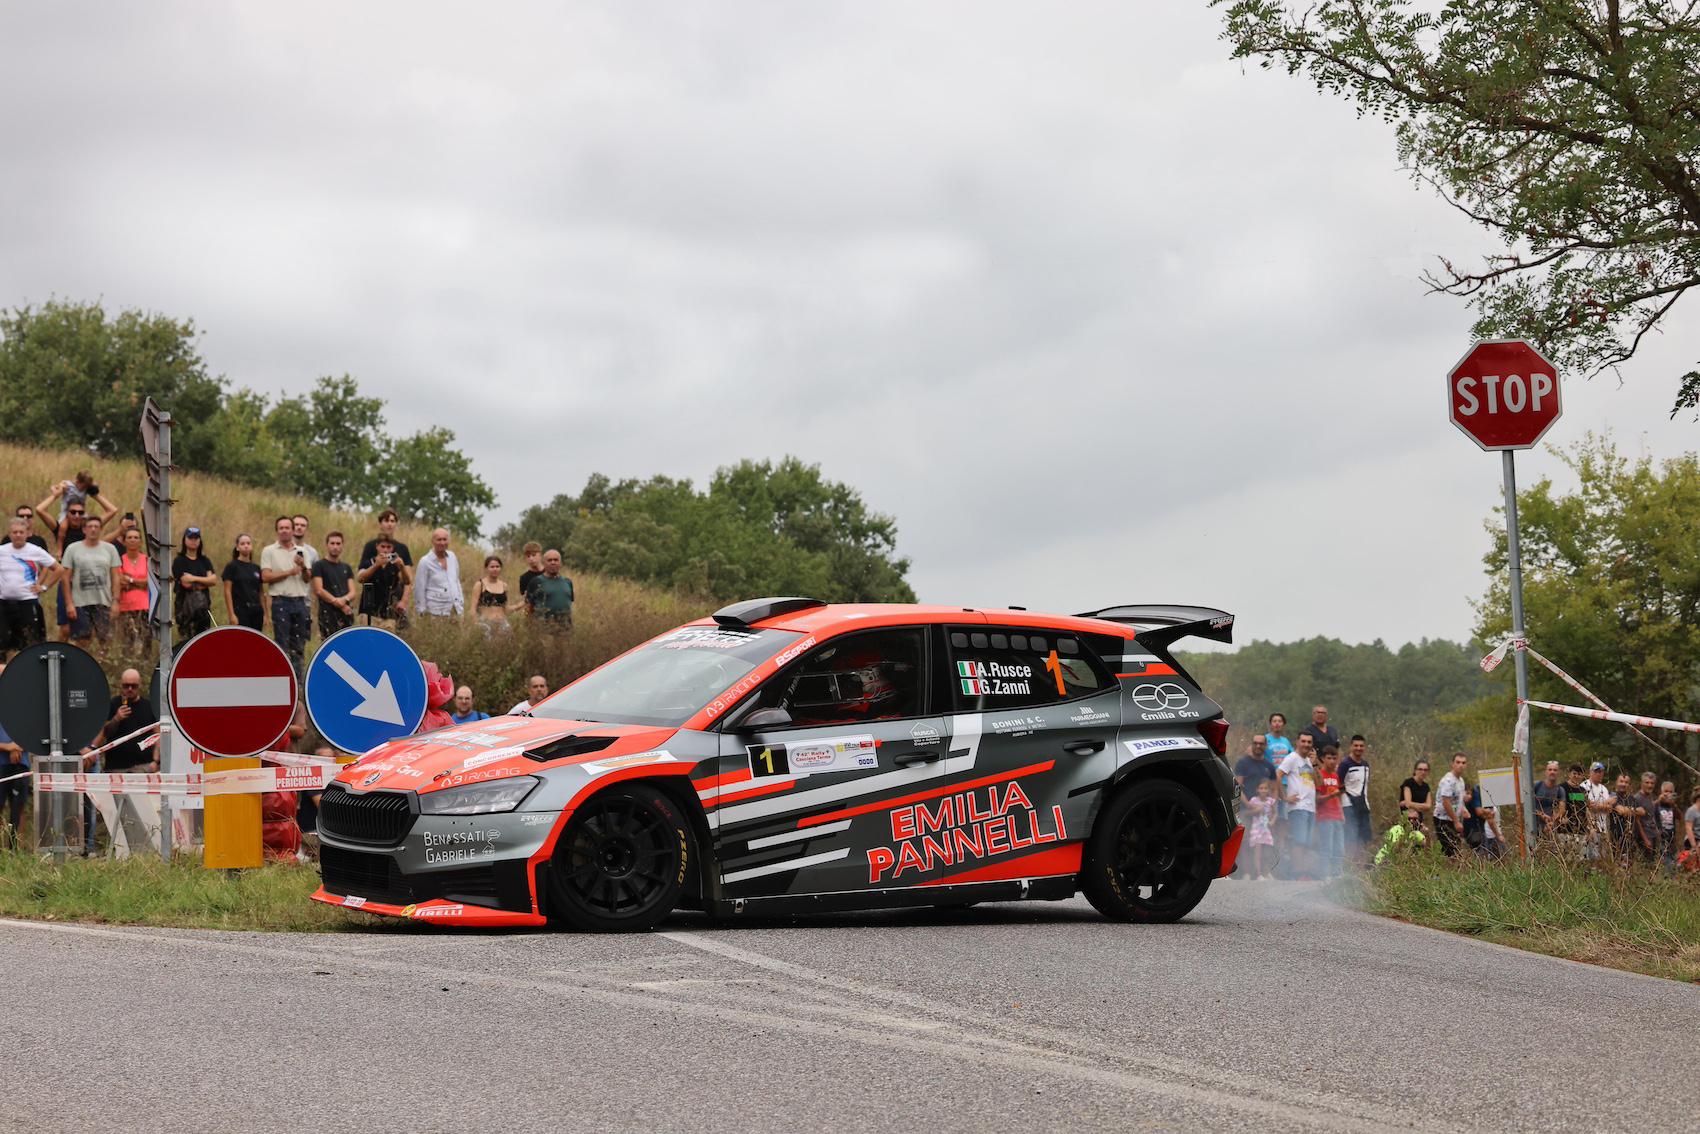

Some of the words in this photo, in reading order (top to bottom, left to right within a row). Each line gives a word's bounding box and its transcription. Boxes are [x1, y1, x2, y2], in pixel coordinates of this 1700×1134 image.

[1456, 373, 1553, 416] STOP
[977, 661, 1032, 678] A.Rusce
[1045, 650, 1067, 696] 1
[981, 679, 1031, 695] G.Zanni
[1141, 711, 1176, 721] Emilia
[1178, 709, 1200, 718] Gru
[992, 718, 1025, 729] BONINI
[467, 750, 521, 766] CONCORRENTE
[759, 747, 775, 774] 1
[285, 766, 312, 777] ZONA
[395, 765, 425, 777] Gru
[466, 766, 521, 781] RACING
[276, 776, 323, 788] PERICOLOSA
[890, 780, 1034, 842] EMILIA
[423, 830, 485, 847] BENASSATI
[866, 804, 1068, 884] PANNELLI
[425, 848, 476, 864] GABRIELE
[413, 904, 464, 917] PIRELLI
